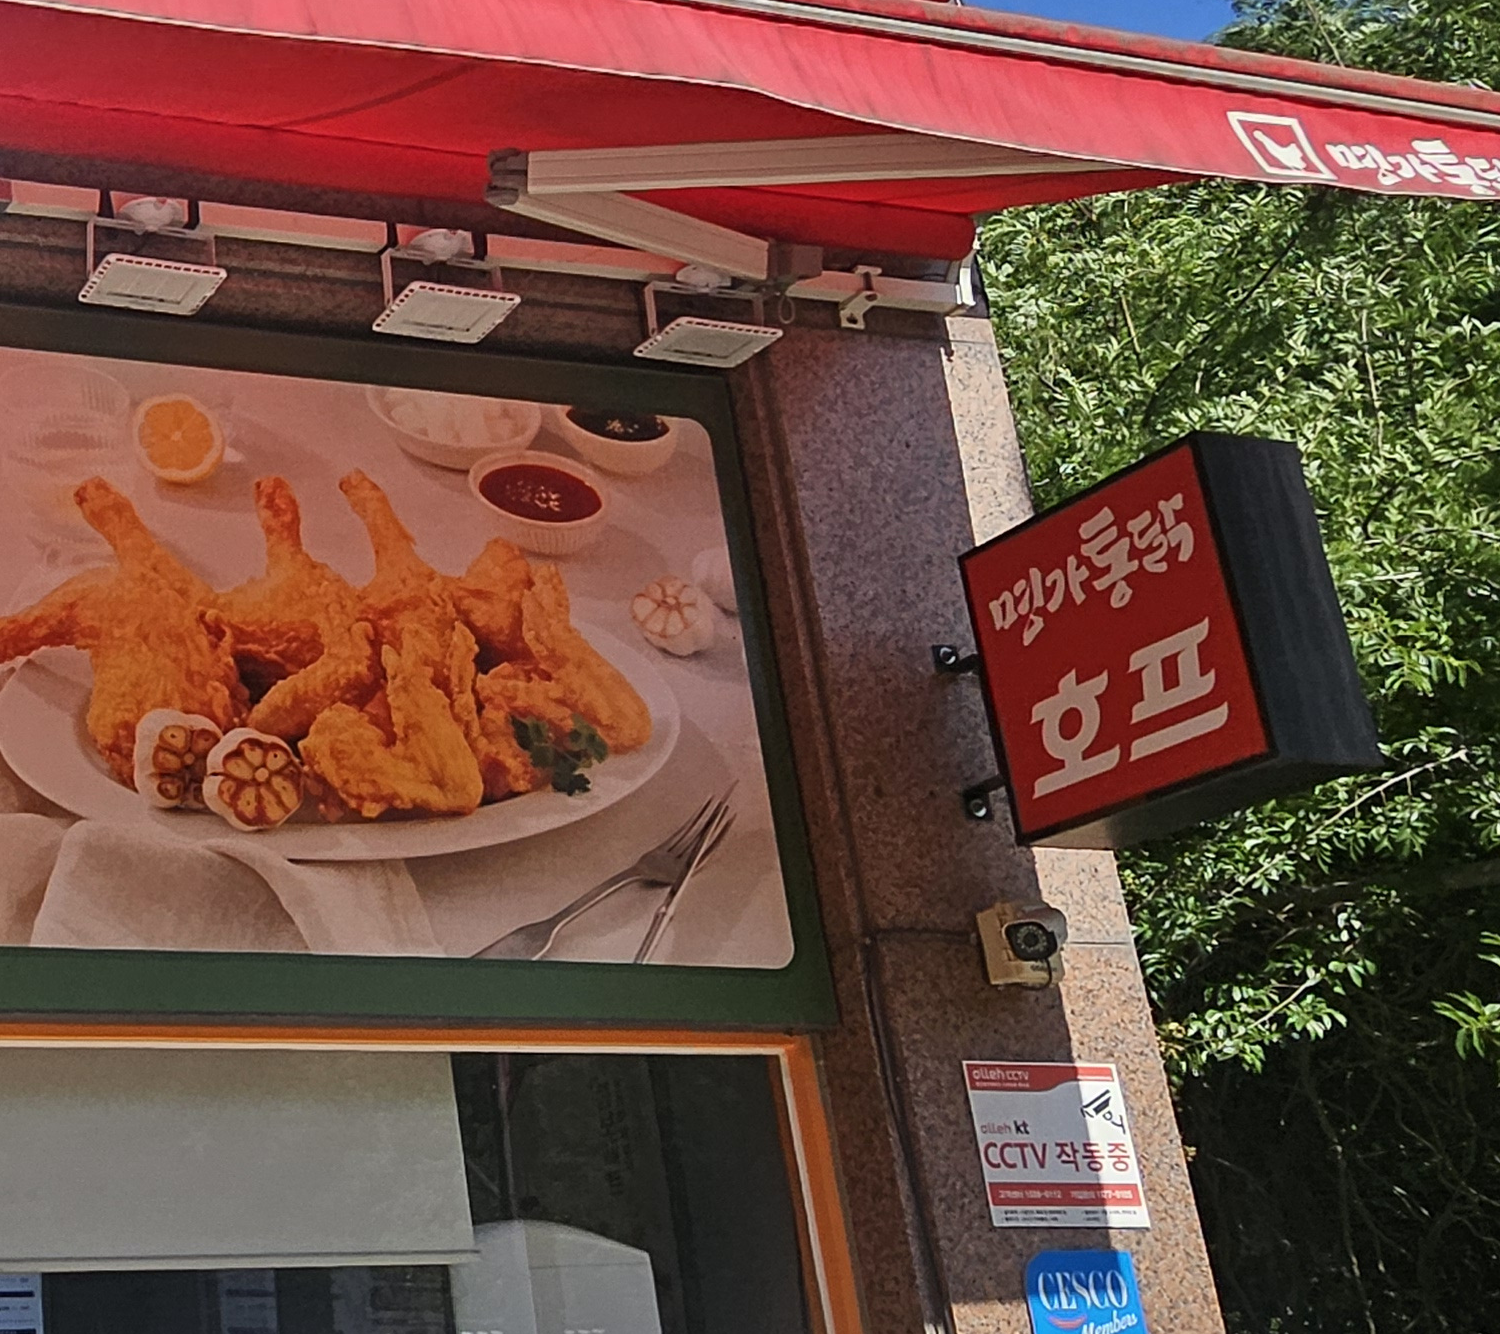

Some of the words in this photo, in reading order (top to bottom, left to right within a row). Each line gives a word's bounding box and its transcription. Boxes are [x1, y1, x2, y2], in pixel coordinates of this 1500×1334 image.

[988, 493, 1195, 647] 명가통닭
[1029, 616, 1229, 800] 호프
[1014, 1119, 1030, 1135] kt
[983, 1141, 1047, 1170] CCTV
[1054, 1141, 1131, 1173] 작동중
[1037, 1269, 1128, 1311] CESCO
